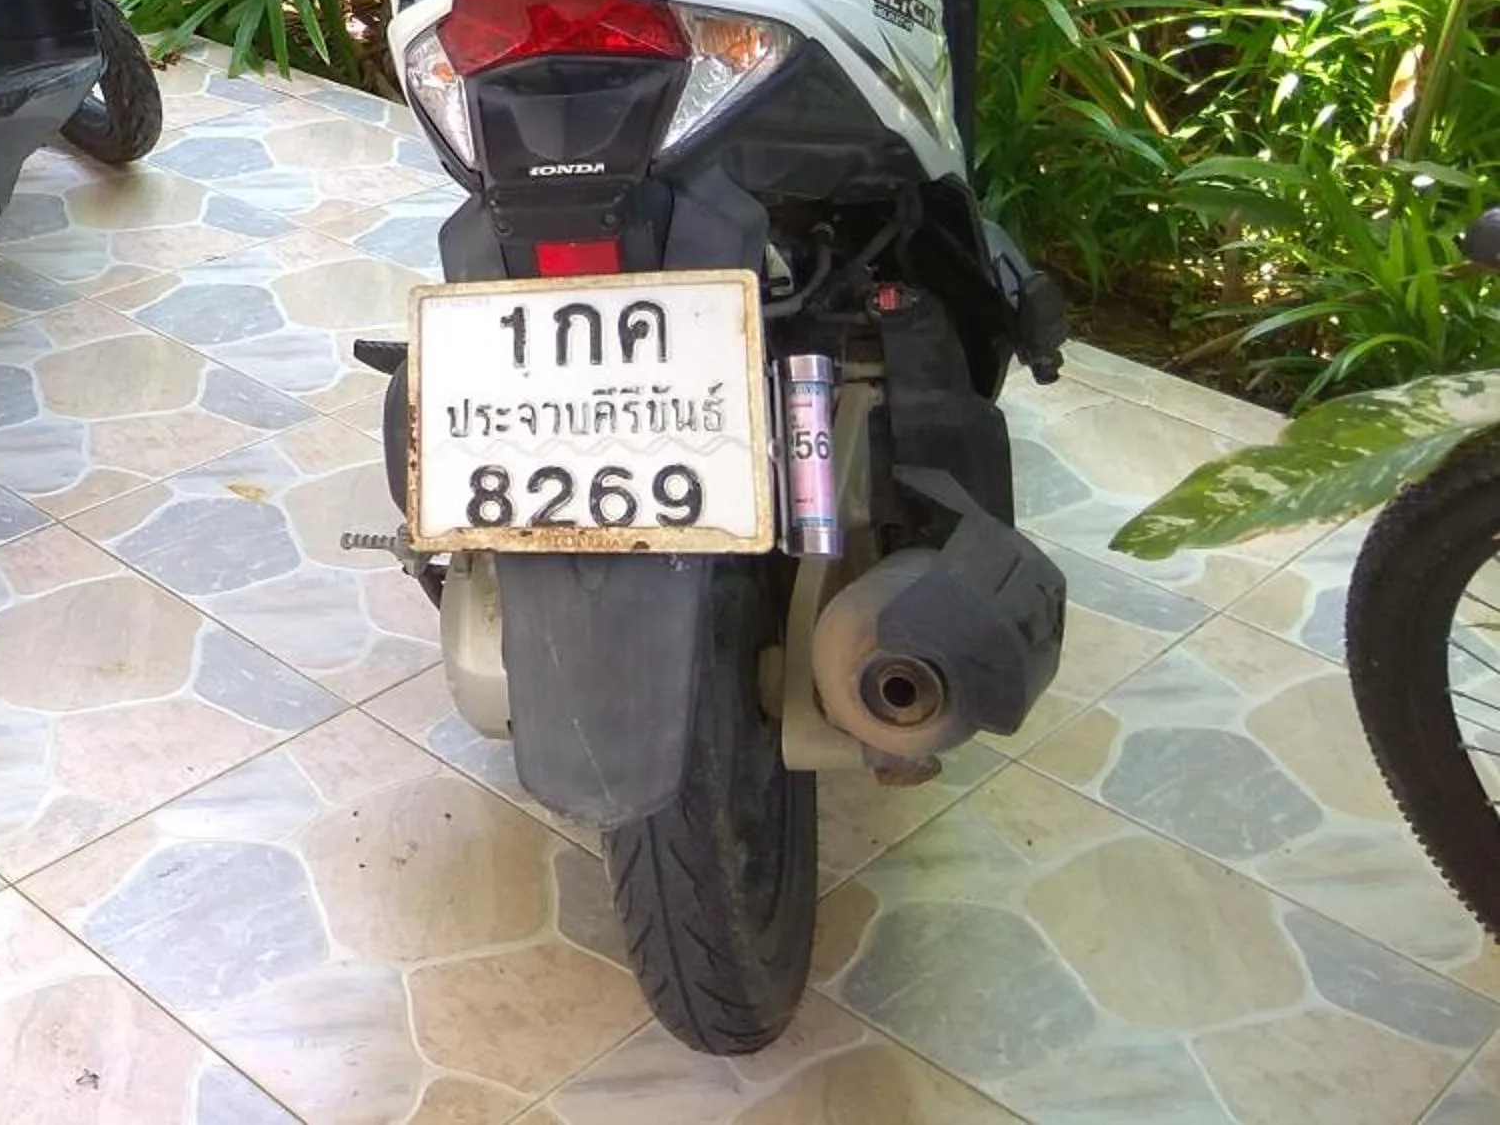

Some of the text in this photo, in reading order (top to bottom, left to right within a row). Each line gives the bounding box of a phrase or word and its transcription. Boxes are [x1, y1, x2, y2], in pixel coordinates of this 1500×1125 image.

[499, 299, 668, 369] 1กค
[790, 429, 831, 461] 56
[465, 464, 704, 528] 8269
